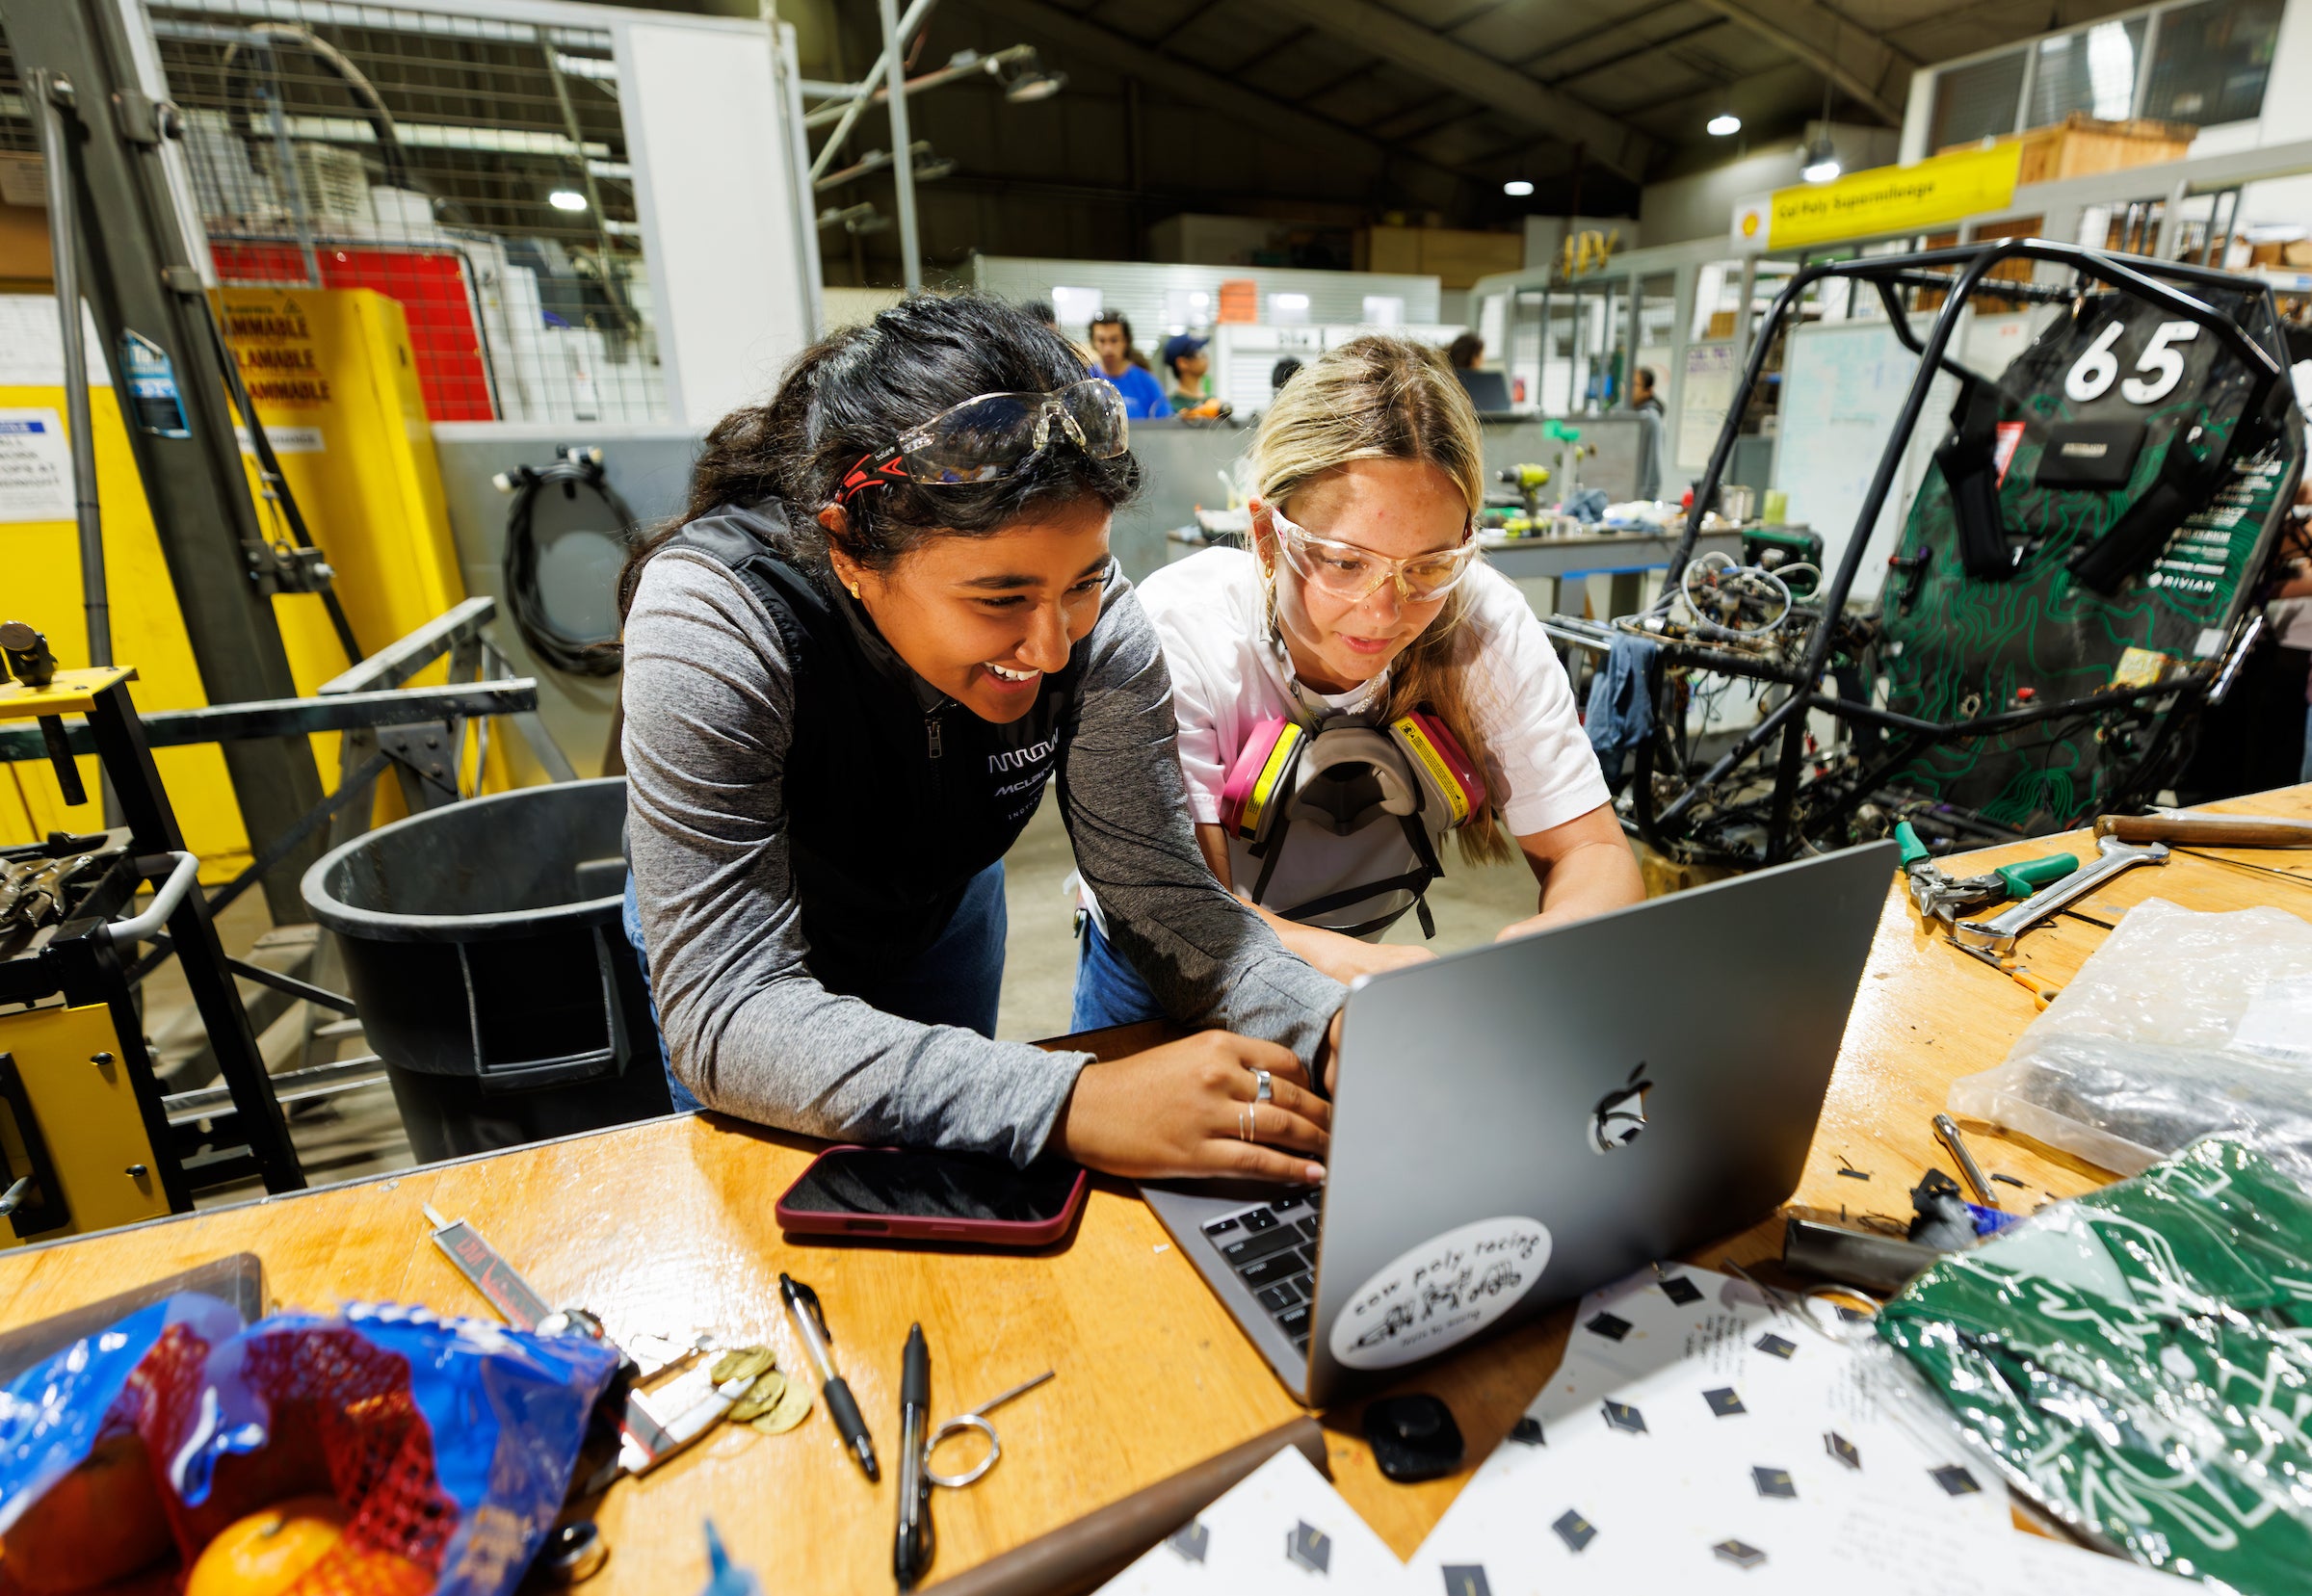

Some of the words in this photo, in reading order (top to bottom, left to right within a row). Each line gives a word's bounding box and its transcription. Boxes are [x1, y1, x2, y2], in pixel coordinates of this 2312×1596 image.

[2064, 320, 2200, 405] 65
[2162, 575, 2217, 593] RIVIAN
[1413, 1249, 1465, 1289] poly
[1475, 1229, 1540, 1260] racing
